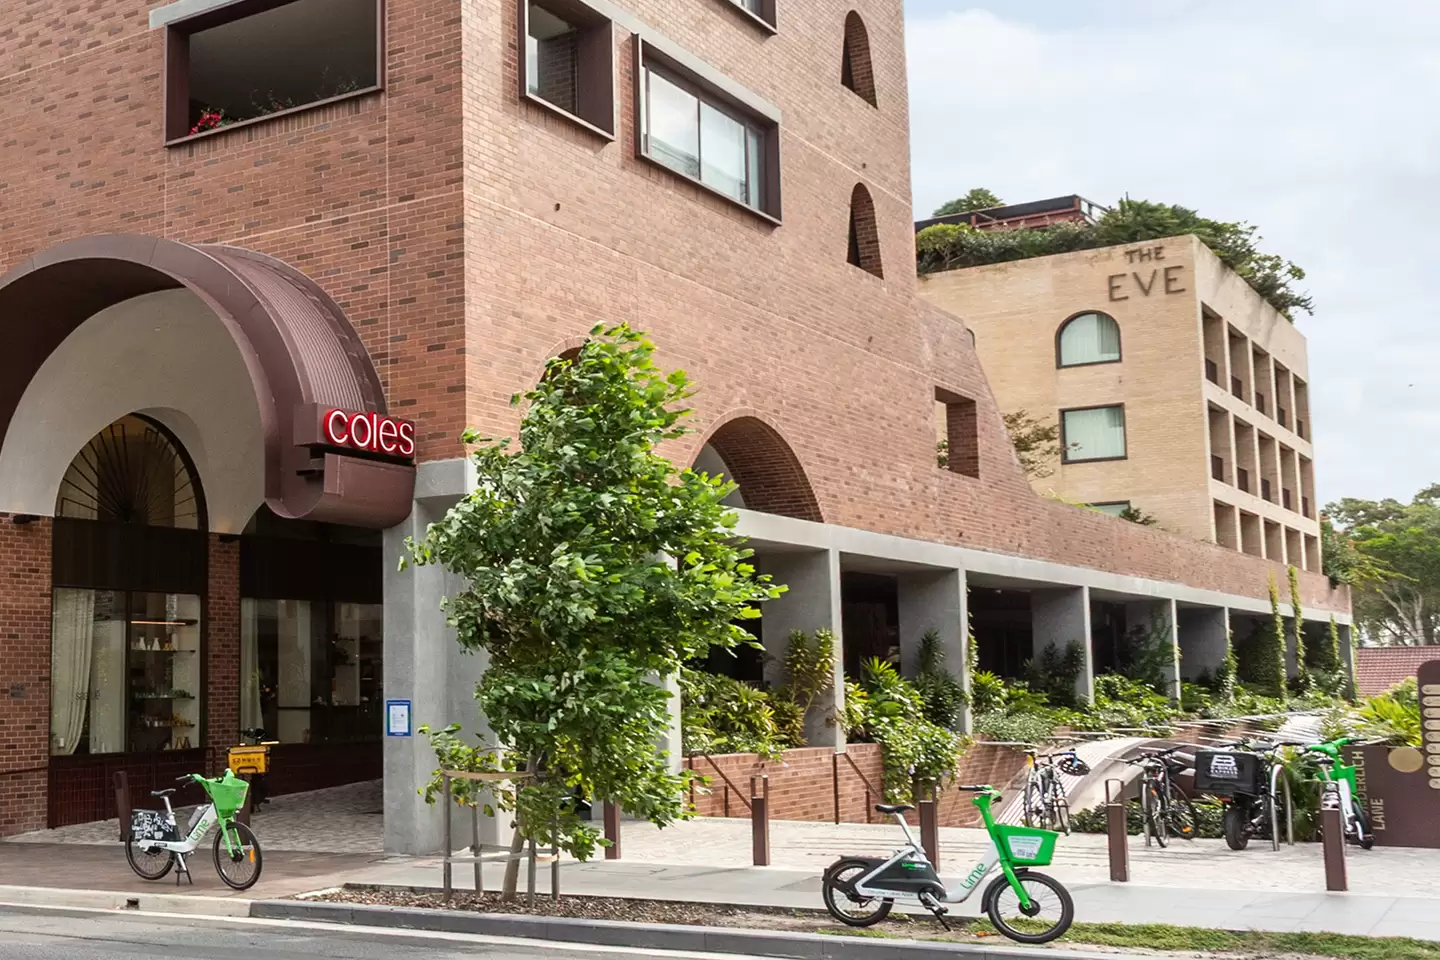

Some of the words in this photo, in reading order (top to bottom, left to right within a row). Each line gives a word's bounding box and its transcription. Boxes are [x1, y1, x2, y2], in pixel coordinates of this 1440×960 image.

[1124, 246, 1166, 264] THE
[1108, 265, 1187, 302] EVE
[324, 409, 415, 456] coles
[1370, 797, 1386, 831] LANE
[190, 819, 210, 841] Lime
[960, 862, 988, 890] Lime
